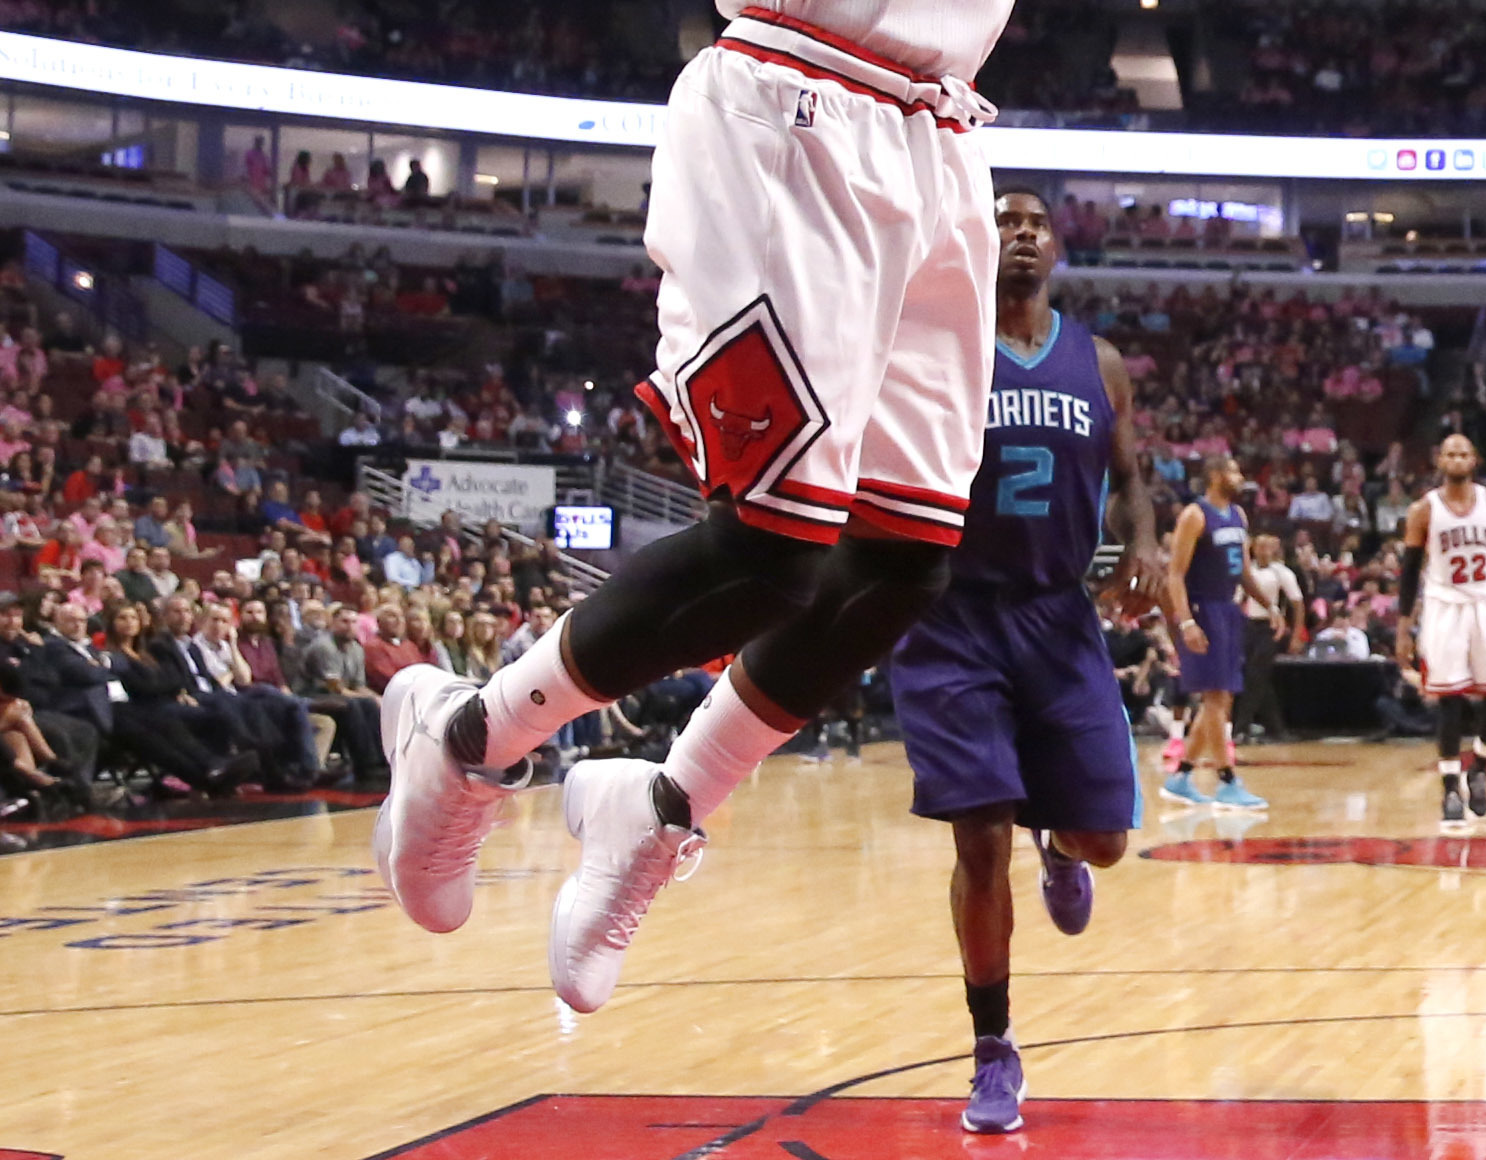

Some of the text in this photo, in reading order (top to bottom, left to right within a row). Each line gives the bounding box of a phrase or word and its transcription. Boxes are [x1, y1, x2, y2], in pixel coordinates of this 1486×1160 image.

[985, 388, 1092, 437] ORNETS
[997, 445, 1054, 516] 2
[1450, 553, 1486, 584] 22
